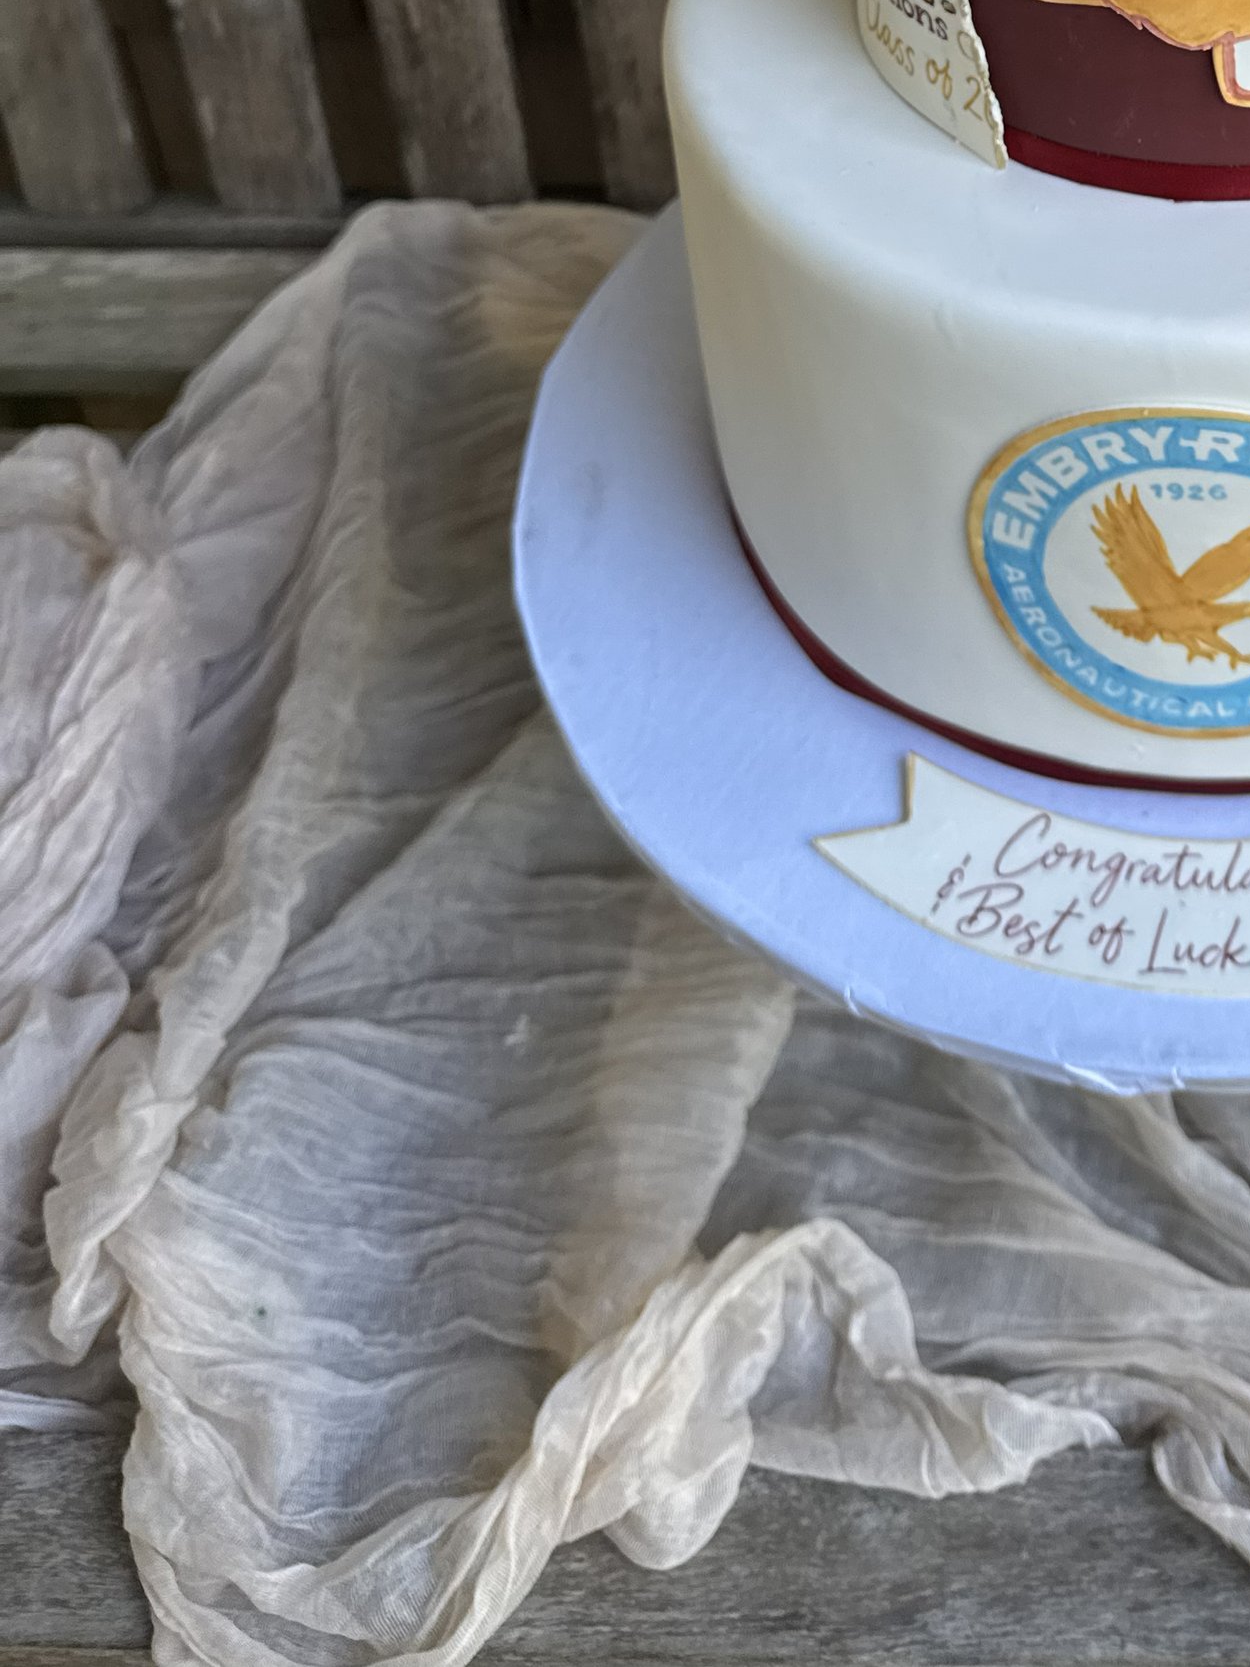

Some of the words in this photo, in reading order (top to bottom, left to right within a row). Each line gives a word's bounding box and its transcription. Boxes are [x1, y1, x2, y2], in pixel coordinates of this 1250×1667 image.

[1149, 482, 1228, 502] 1926
[1002, 563, 1236, 718] AERONAUTICAL
[956, 881, 1085, 956] Best
[1087, 915, 1136, 965] of
